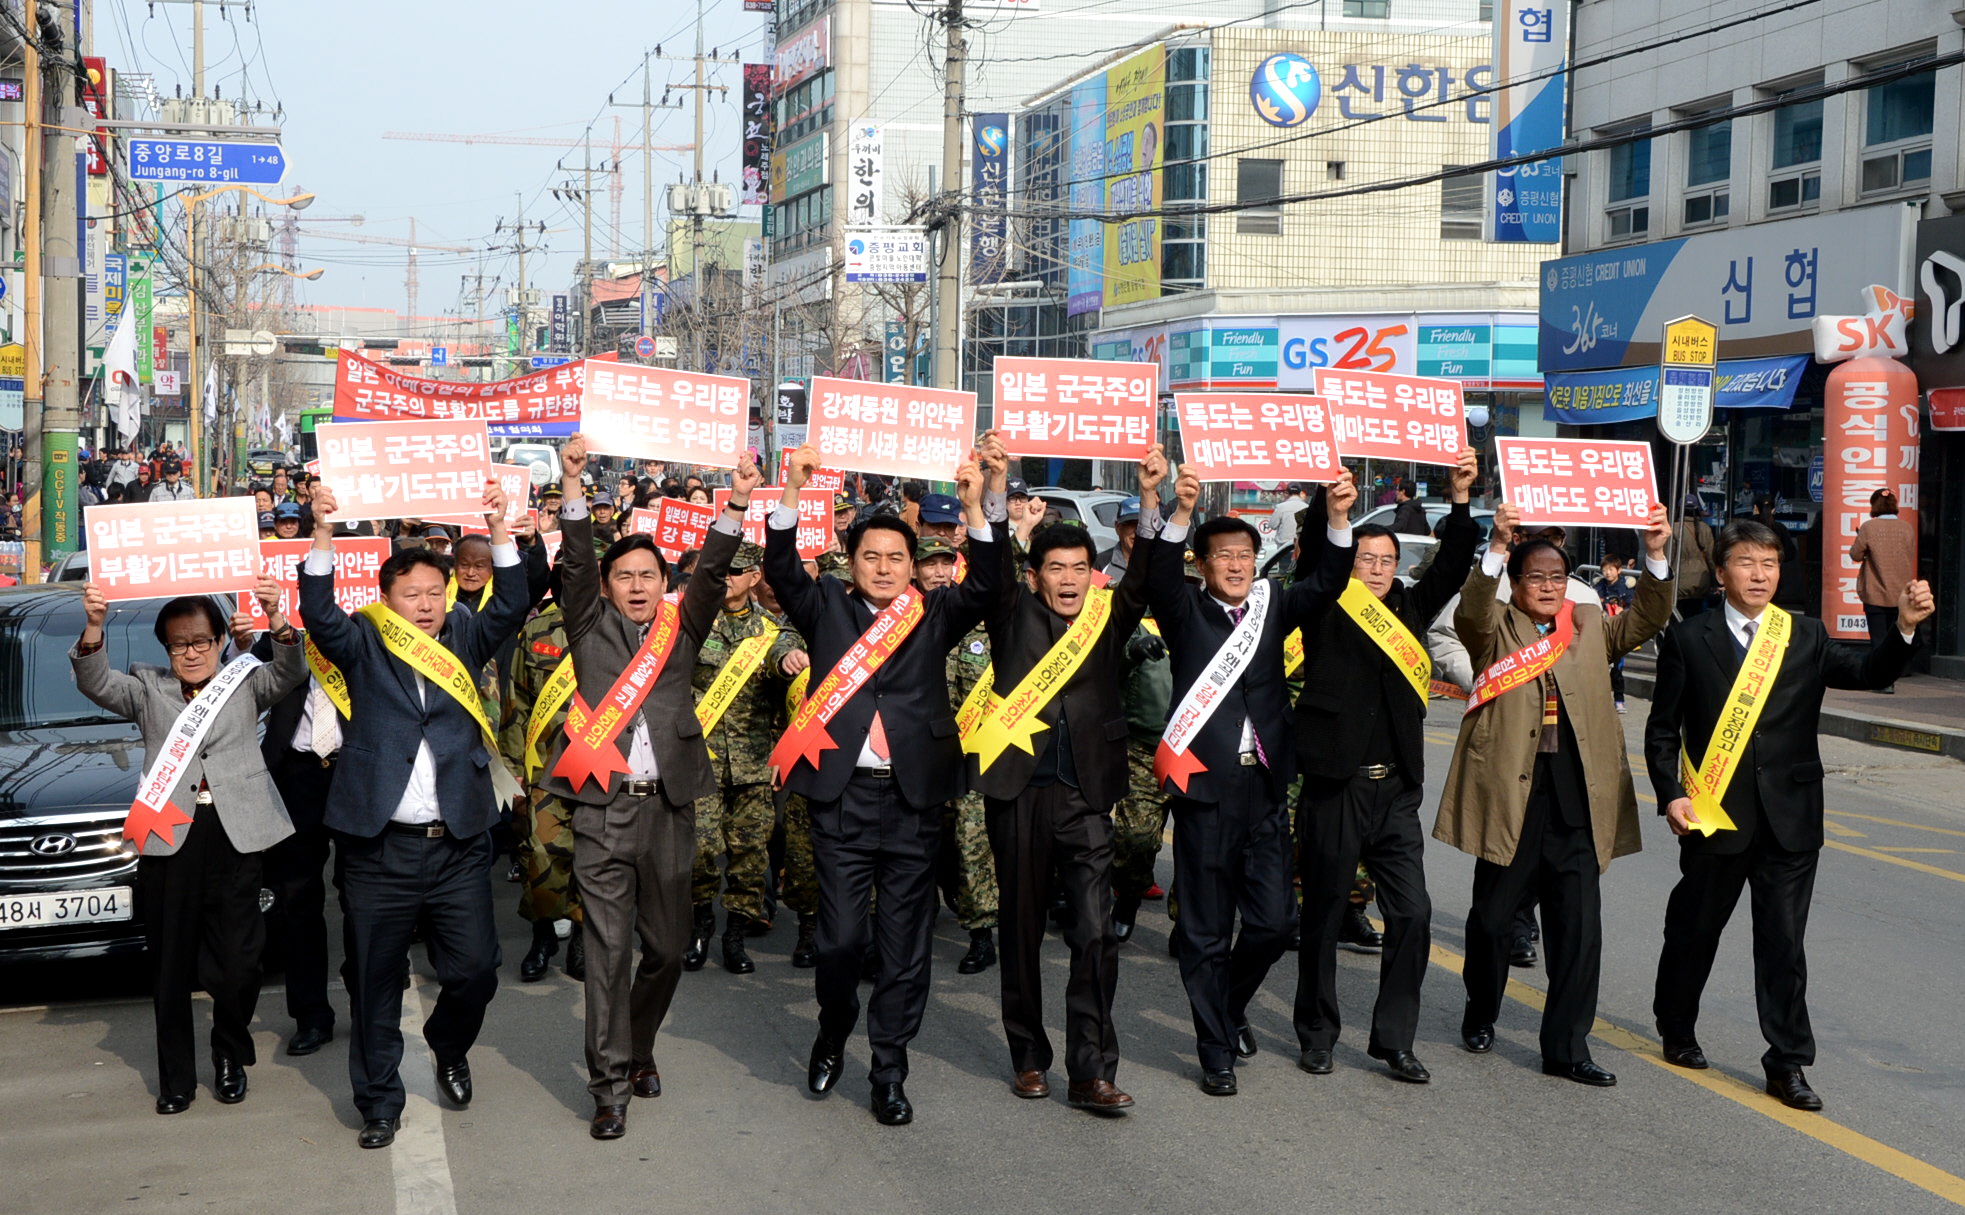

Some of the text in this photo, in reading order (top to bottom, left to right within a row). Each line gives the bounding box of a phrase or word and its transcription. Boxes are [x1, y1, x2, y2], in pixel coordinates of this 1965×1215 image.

[1519, 8, 1552, 43] 협
[134, 143, 223, 165] 중앙로8길
[1542, 165, 1560, 177] 코너
[135, 165, 239, 180] Jungang-ro 8-gil
[1520, 191, 1559, 207] 증평신협
[1500, 213, 1528, 224] CREDIT
[869, 242, 923, 254] 증평교회
[1561, 258, 1646, 290] 증평신협 CREDIT UNION
[1721, 247, 1819, 325] 신협
[1222, 331, 1265, 347] Friendly
[1429, 328, 1476, 346] Friendly
[1562, 300, 1618, 355] 365 코너
[1672, 336, 1709, 347] 시내버스
[1836, 313, 1896, 352] SK
[1, 355, 24, 364] 시내버
[1283, 324, 1410, 374] GS25
[1673, 350, 1706, 362] BUS STOP
[160, 375, 175, 391] 약
[346, 358, 380, 385] 일본
[1232, 362, 1254, 377] Fun
[1440, 361, 1464, 376] Fun
[354, 388, 584, 422] 군국주의 부활기도를 규탄한
[592, 370, 742, 416] 독도는 우리땅
[1000, 371, 1151, 408] 일본 군국주의
[1322, 377, 1457, 417] 독도는 우리땅
[1623, 379, 1651, 407] 최선을
[821, 391, 964, 432] 강제동원 위안부
[1000, 409, 1149, 445] 부활기도규탄
[1185, 402, 1325, 433] 독도는 우리땅
[325, 432, 486, 469] 일본 군국주의
[677, 418, 738, 453] 우리땅
[819, 425, 962, 468] 정중히 사과 보상하라
[1333, 414, 1459, 453] 대마도도 우리땅
[1192, 438, 1331, 470] 대마도도 우리땅
[1507, 446, 1645, 480] 독도는 우리땅
[54, 469, 65, 509] CCTV
[331, 469, 488, 505] 부활기도규탄
[1513, 483, 1650, 518] 대마도도 우리땅
[54, 511, 67, 543] 작동중
[93, 512, 254, 549] 일본 군국주의
[98, 547, 253, 586] 부활기도규탄
[650, 621, 672, 657] 영유권
[865, 615, 896, 646] 침탈
[1233, 630, 1255, 656] 역사
[1359, 603, 1420, 669] 일본의 독도침탈
[381, 618, 477, 704] 일본의 독도침탈 야욕을
[629, 651, 658, 689] 주장을
[730, 650, 755, 679] 역사를
[817, 595, 924, 724] 케시마의 날 폐기하고
[838, 643, 868, 675] 만행
[1031, 650, 1073, 694] 인정하고
[1209, 651, 1241, 688] 왜곡을
[1488, 638, 1552, 681] 독도 침탈
[1497, 641, 1565, 692] 다케시마의
[1751, 638, 1779, 674] 침략의
[201, 684, 226, 706] 역사
[615, 682, 638, 710] 즉각
[707, 675, 737, 710] 인정하고
[795, 673, 841, 732] 중단하라
[1194, 682, 1218, 709] 강력
[1480, 683, 1496, 701] 날
[1736, 670, 1765, 708] 역사를
[180, 703, 211, 739] 왜곡을
[583, 704, 623, 750] 철회하라
[1000, 689, 1039, 731] 사죄하라
[1167, 704, 1201, 749] 규탄한다
[1716, 705, 1751, 754] 인정하고
[169, 736, 191, 763] 강력
[144, 760, 178, 807] 규탄한다
[55, 893, 118, 920] 3704
